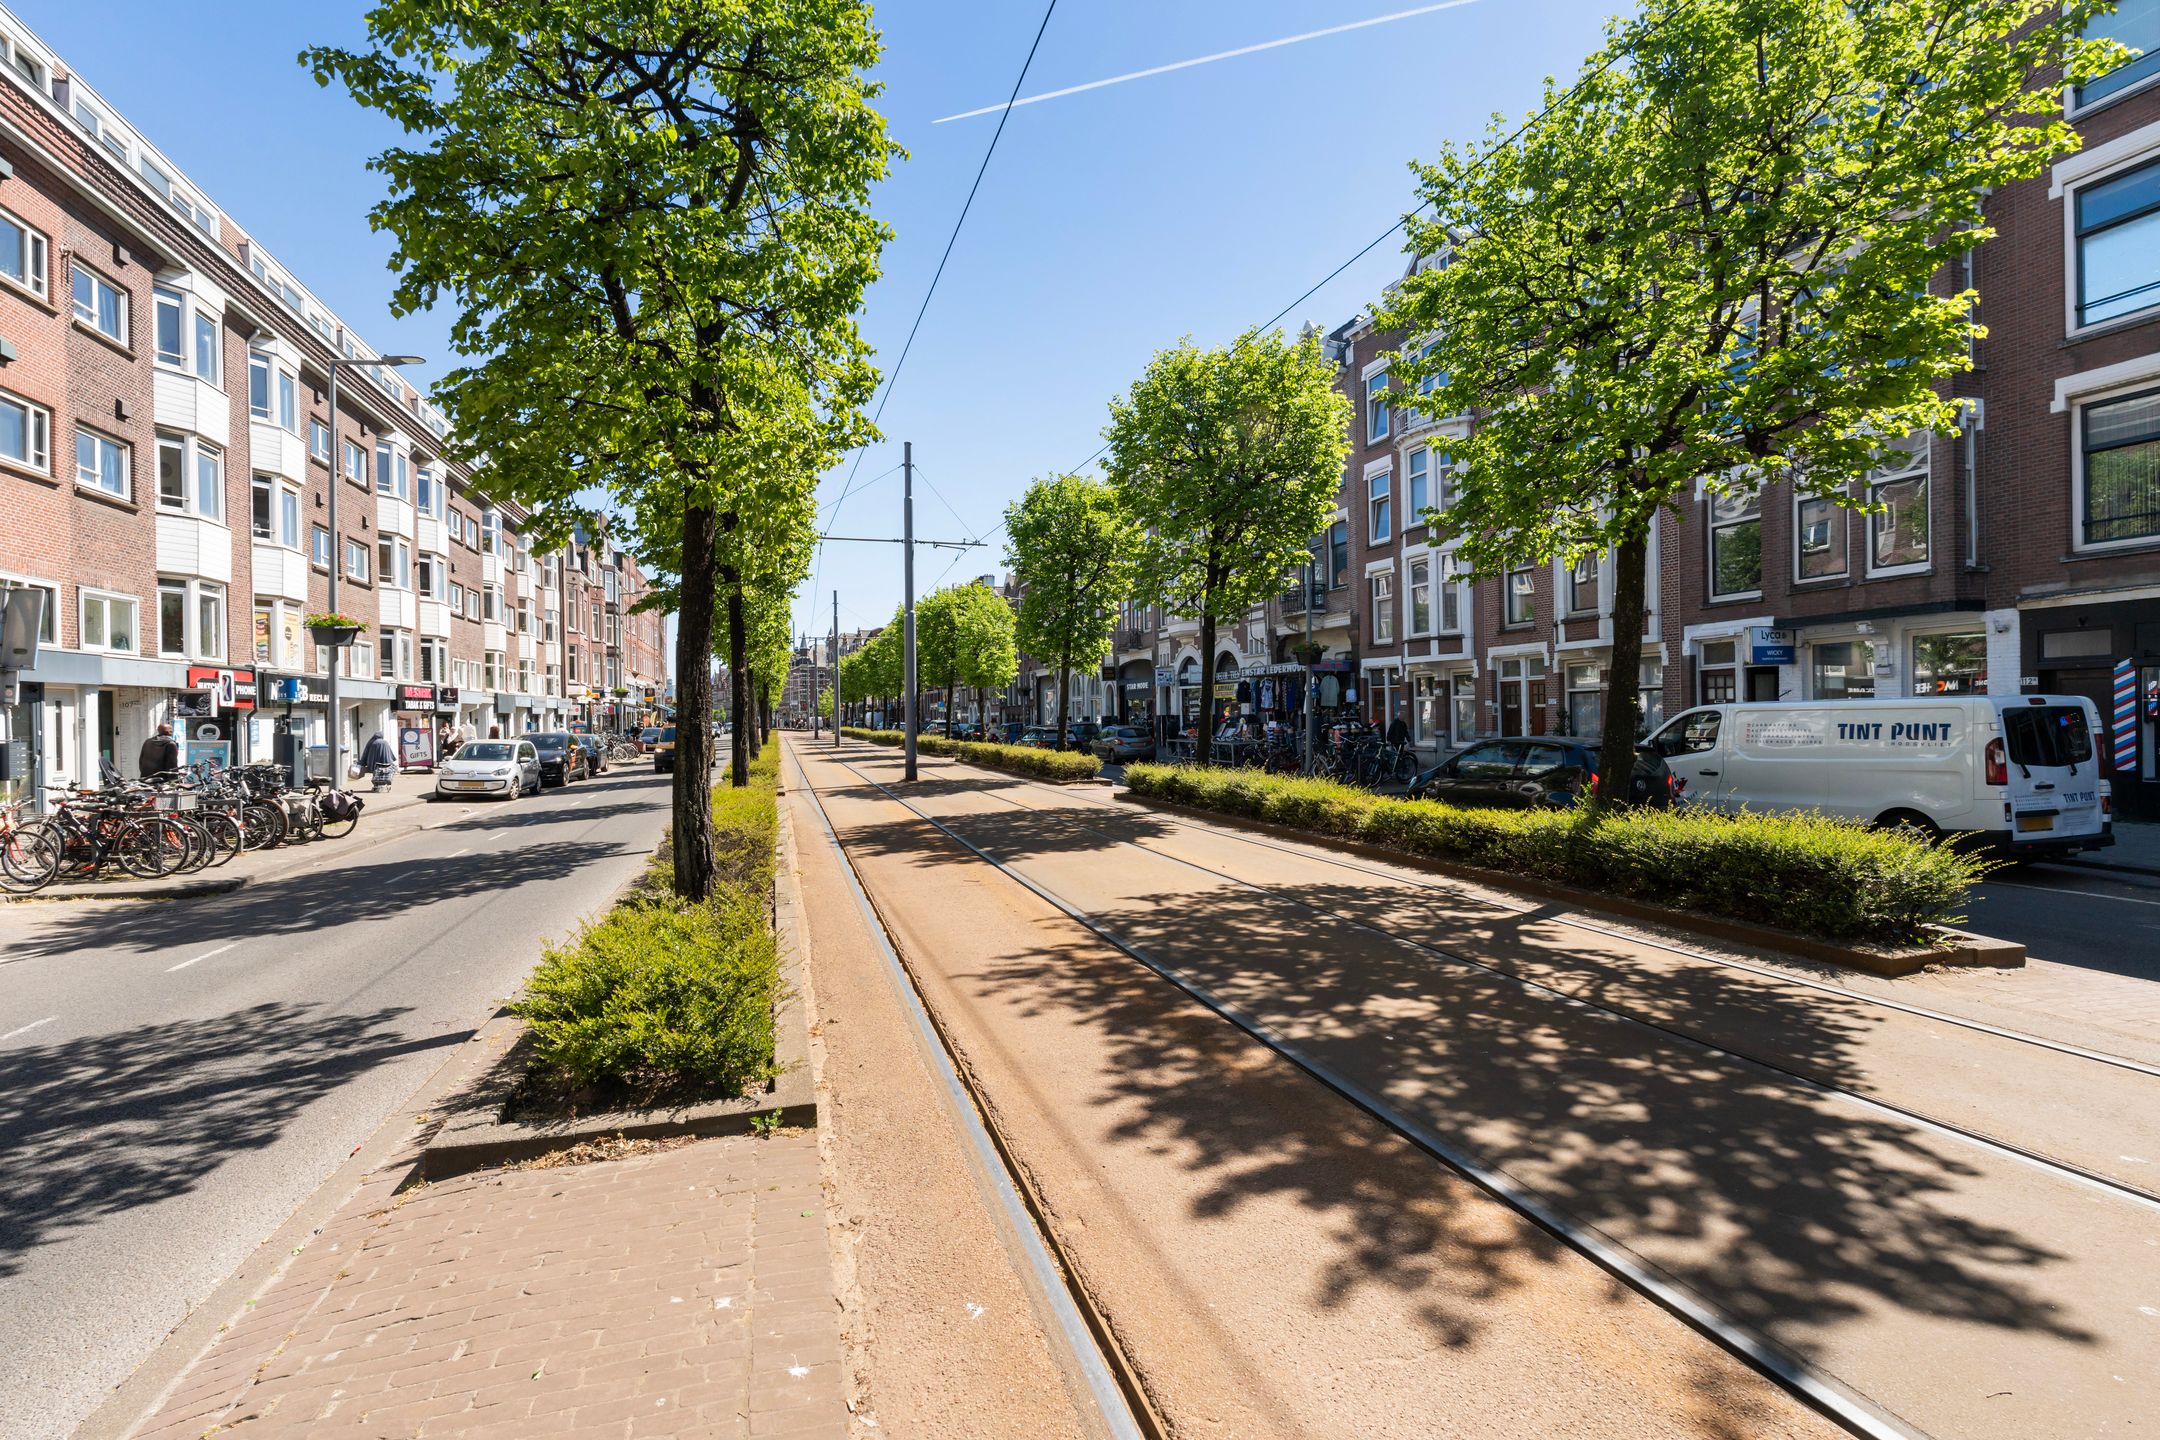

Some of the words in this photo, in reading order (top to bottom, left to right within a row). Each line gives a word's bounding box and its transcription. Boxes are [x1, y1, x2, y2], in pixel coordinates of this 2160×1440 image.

[1761, 630, 1780, 640] Lyca
[235, 685, 257, 695] PHONE
[309, 693, 329, 702] RECLA
[1838, 723, 1882, 740] TINT
[1891, 722, 1951, 741] PUNT
[2063, 793, 2079, 803] TINT
